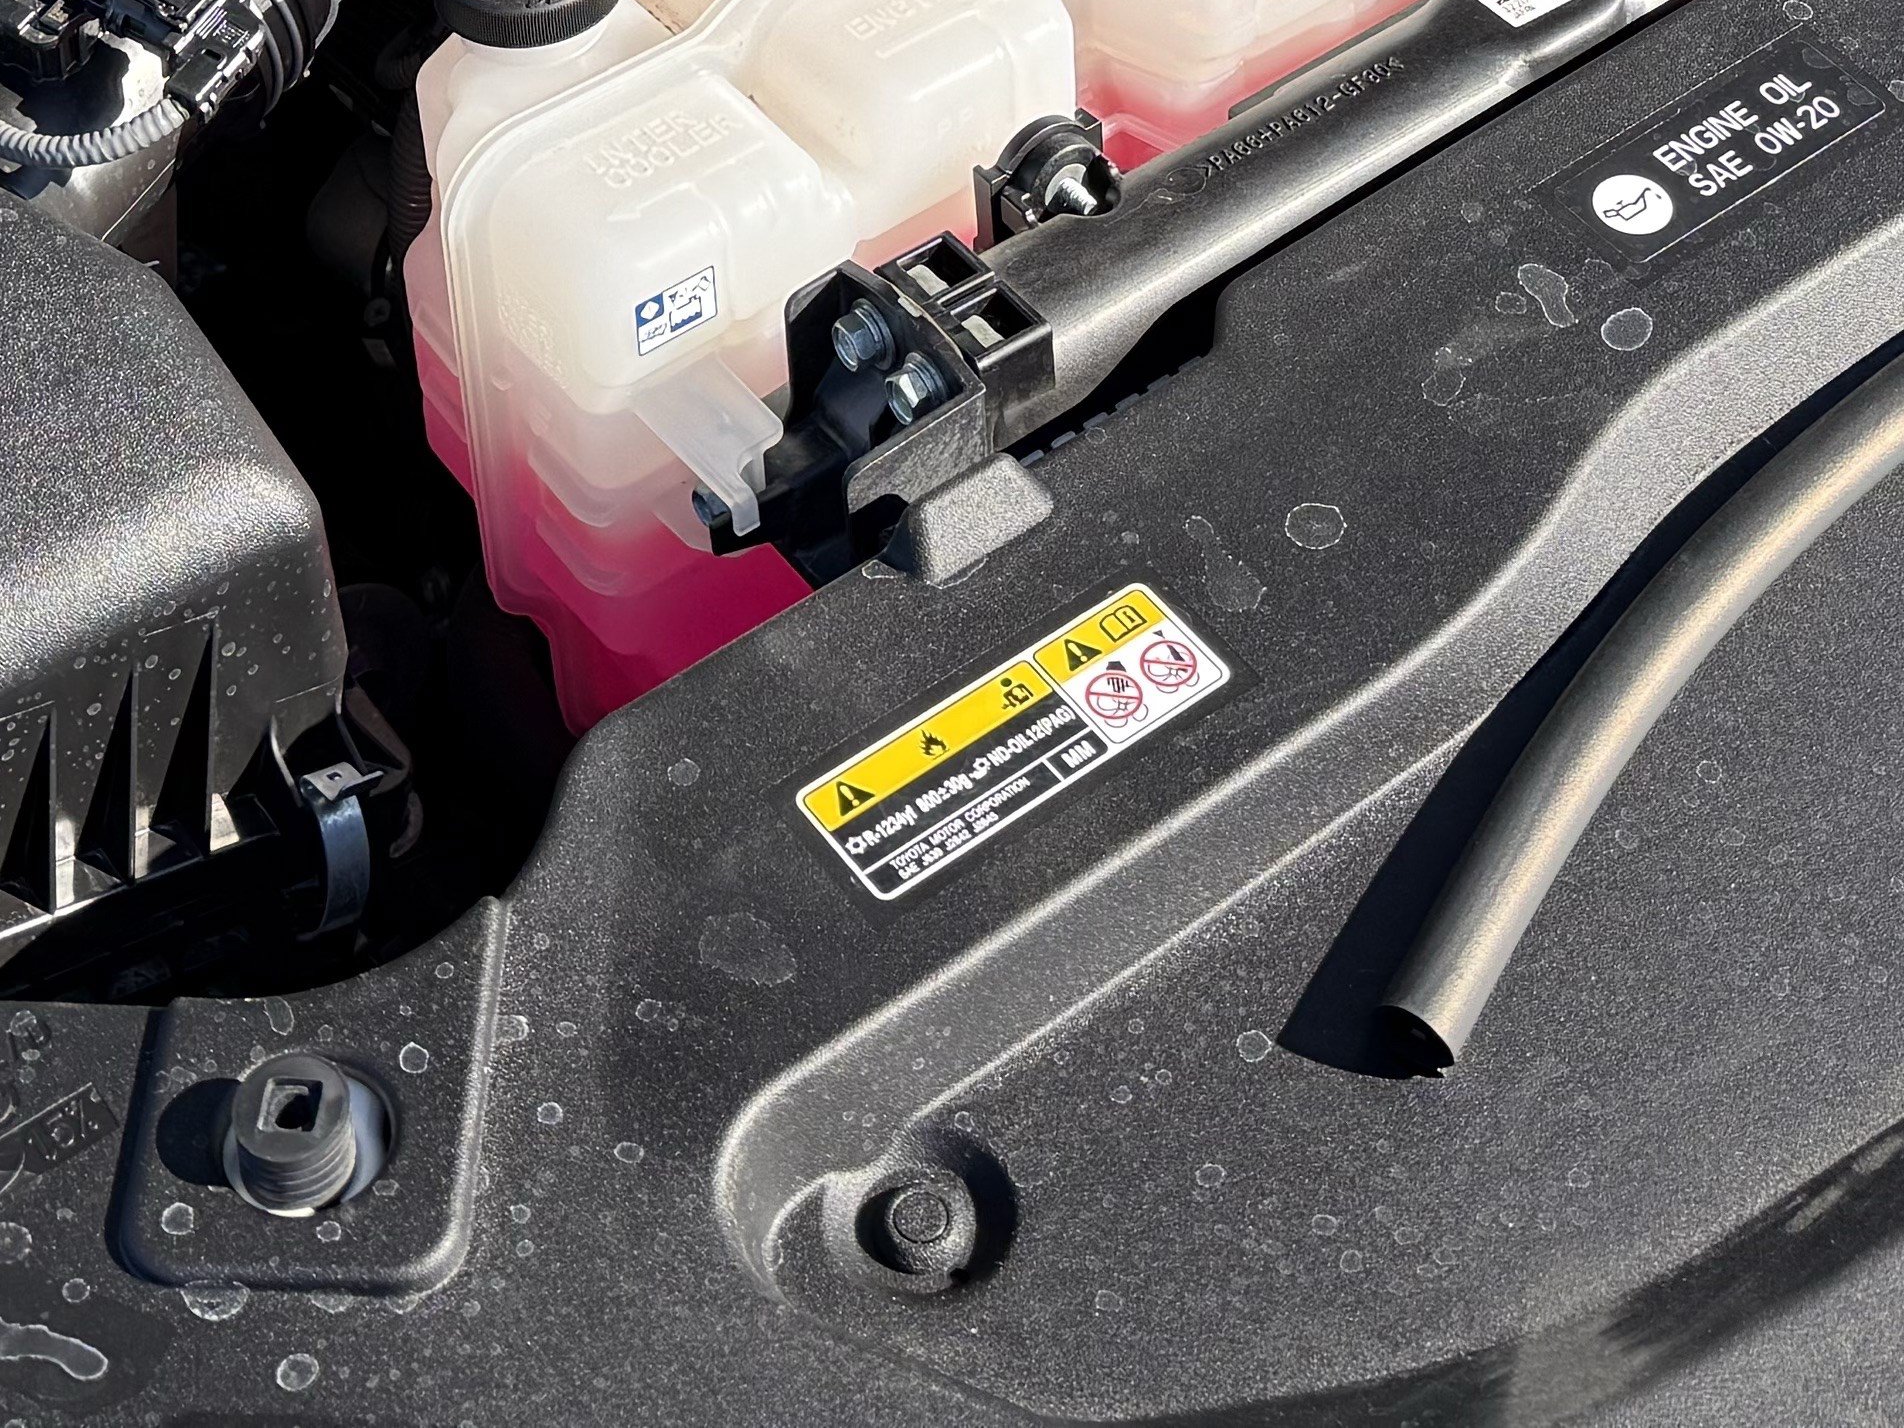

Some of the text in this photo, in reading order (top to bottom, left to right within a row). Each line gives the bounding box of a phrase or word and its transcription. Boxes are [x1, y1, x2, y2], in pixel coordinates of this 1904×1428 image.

[582, 108, 699, 173] INTER
[603, 113, 744, 190] COOLER
[1652, 73, 1813, 175] ENGINE OIL
[1686, 94, 1842, 198] SAE 0W-20
[1060, 739, 1097, 769] MM
[889, 776, 1031, 870] TOYOTA MOTOR CORPORATION
